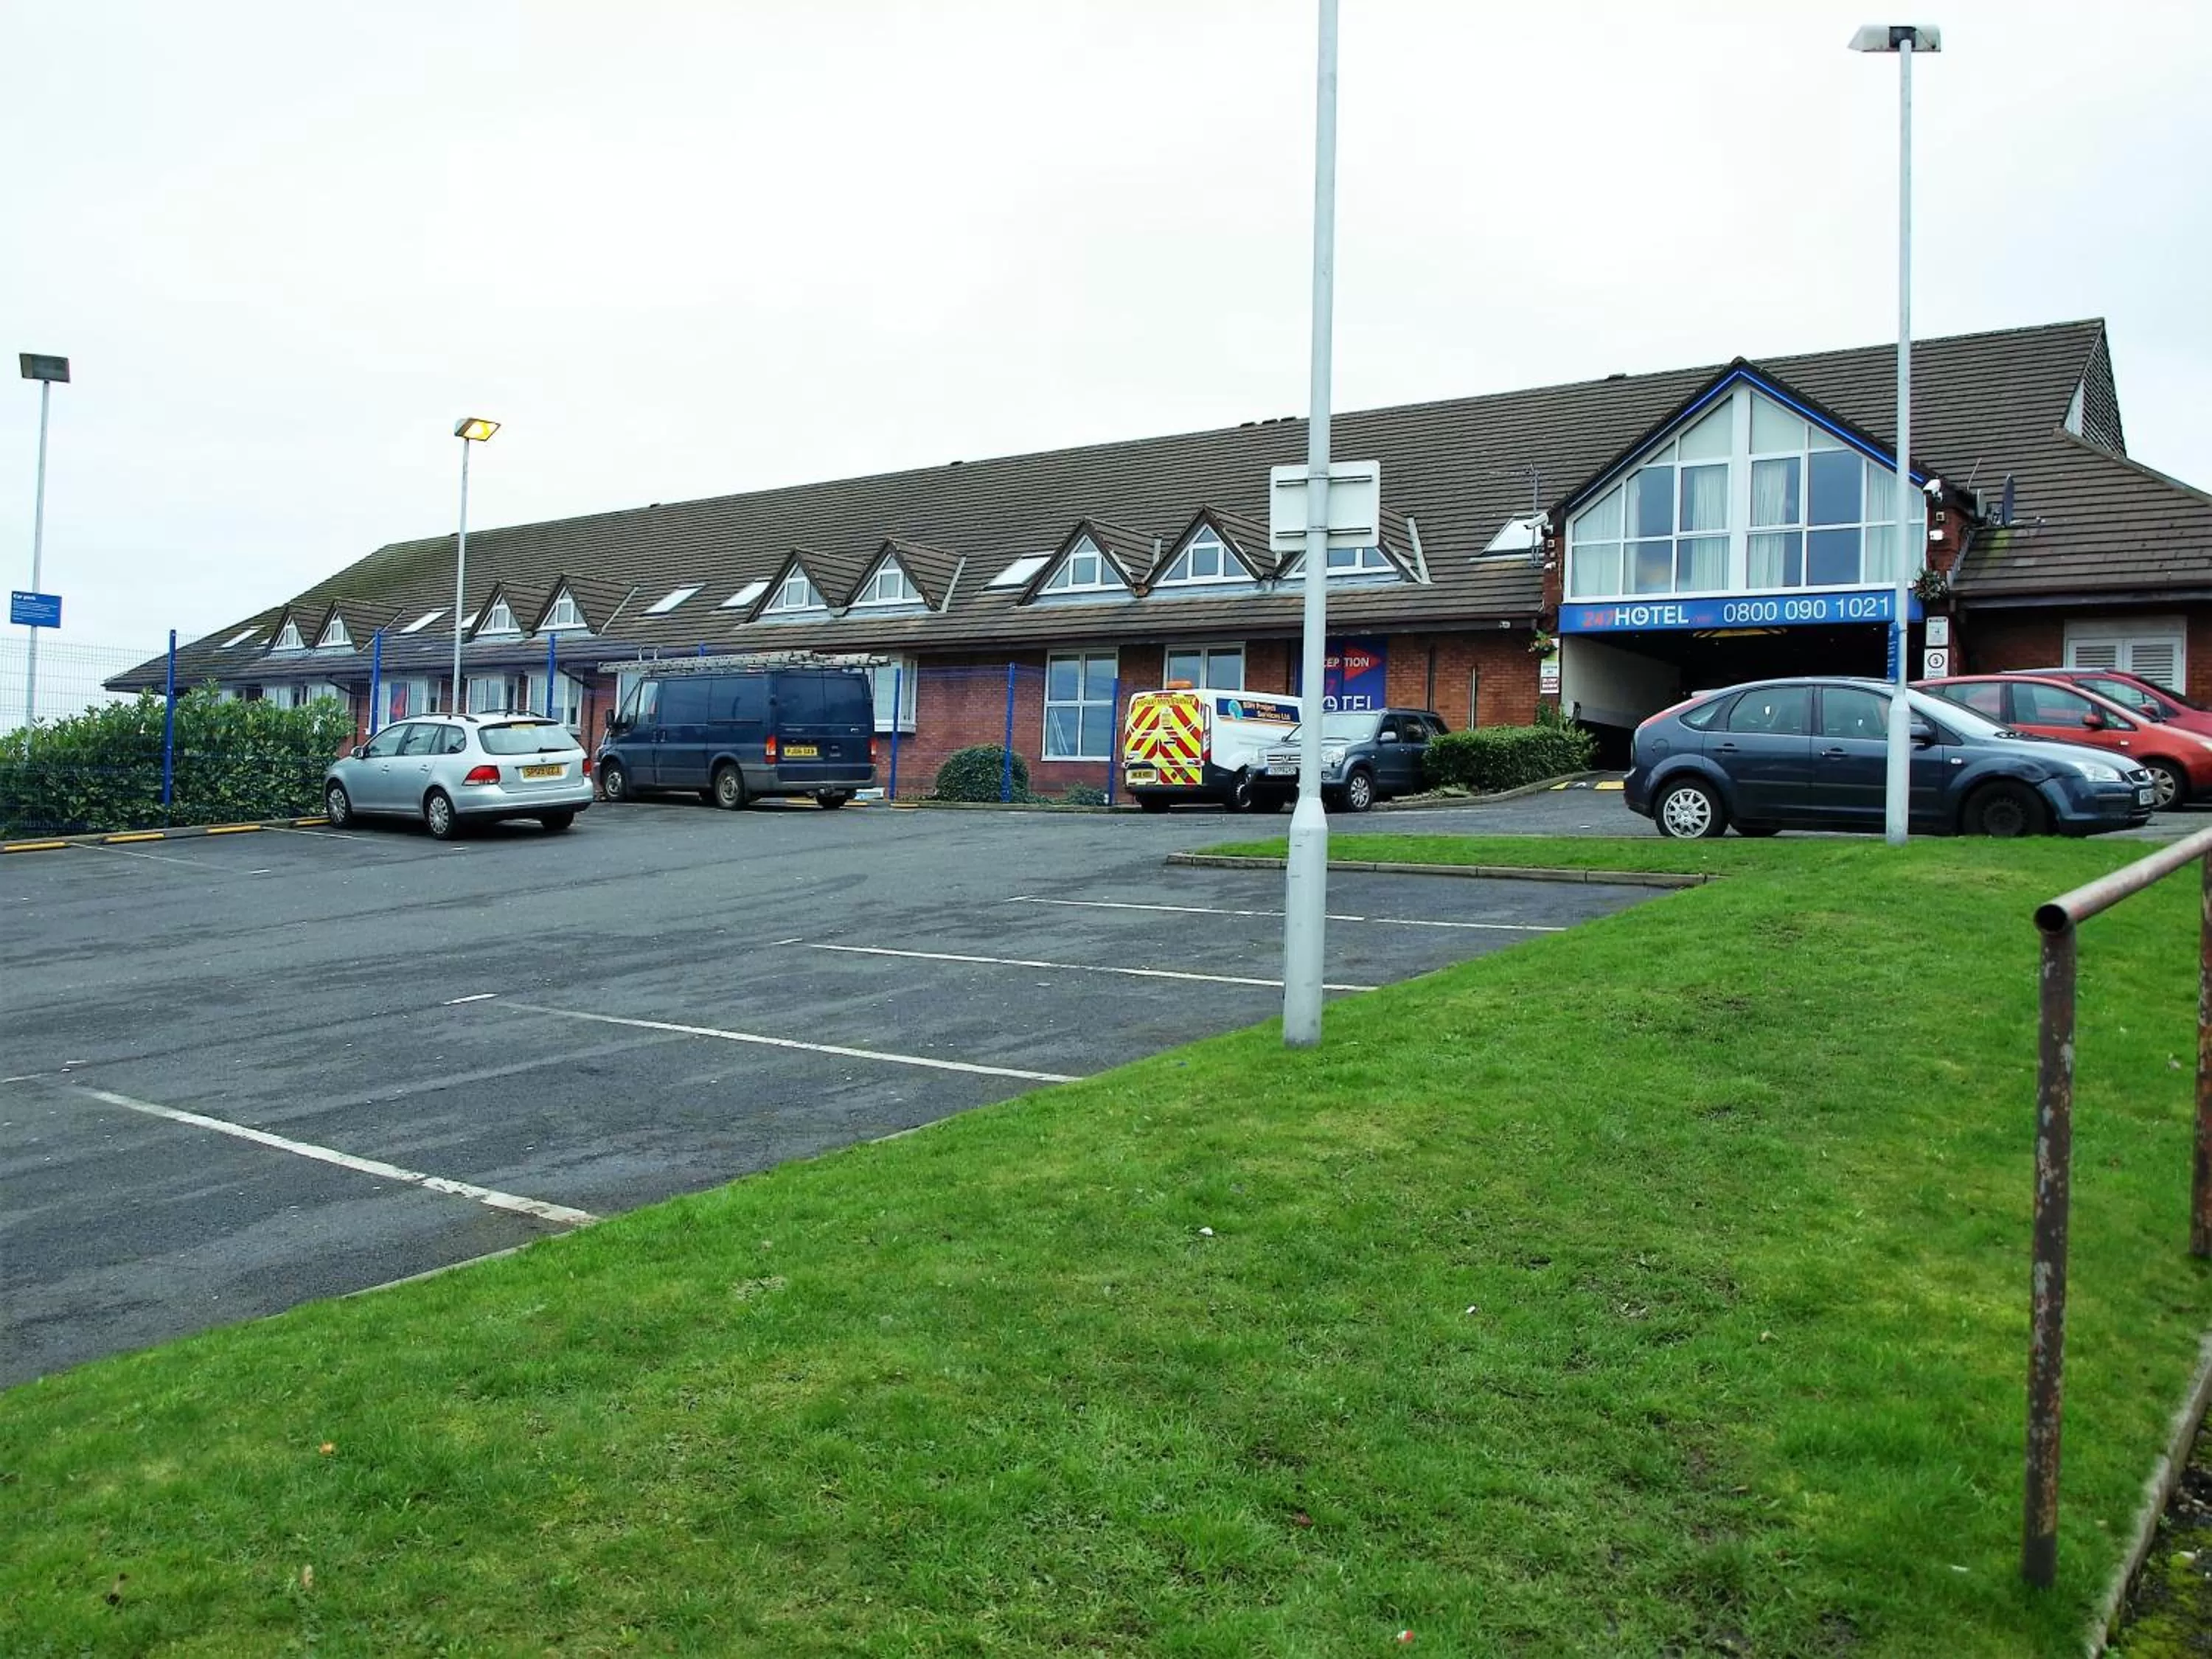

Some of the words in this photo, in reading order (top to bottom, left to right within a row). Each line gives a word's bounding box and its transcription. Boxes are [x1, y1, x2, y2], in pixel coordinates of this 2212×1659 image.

[1723, 601, 1778, 622] 0800
[1784, 599, 1826, 620] 090
[1835, 596, 1888, 618] 1021
